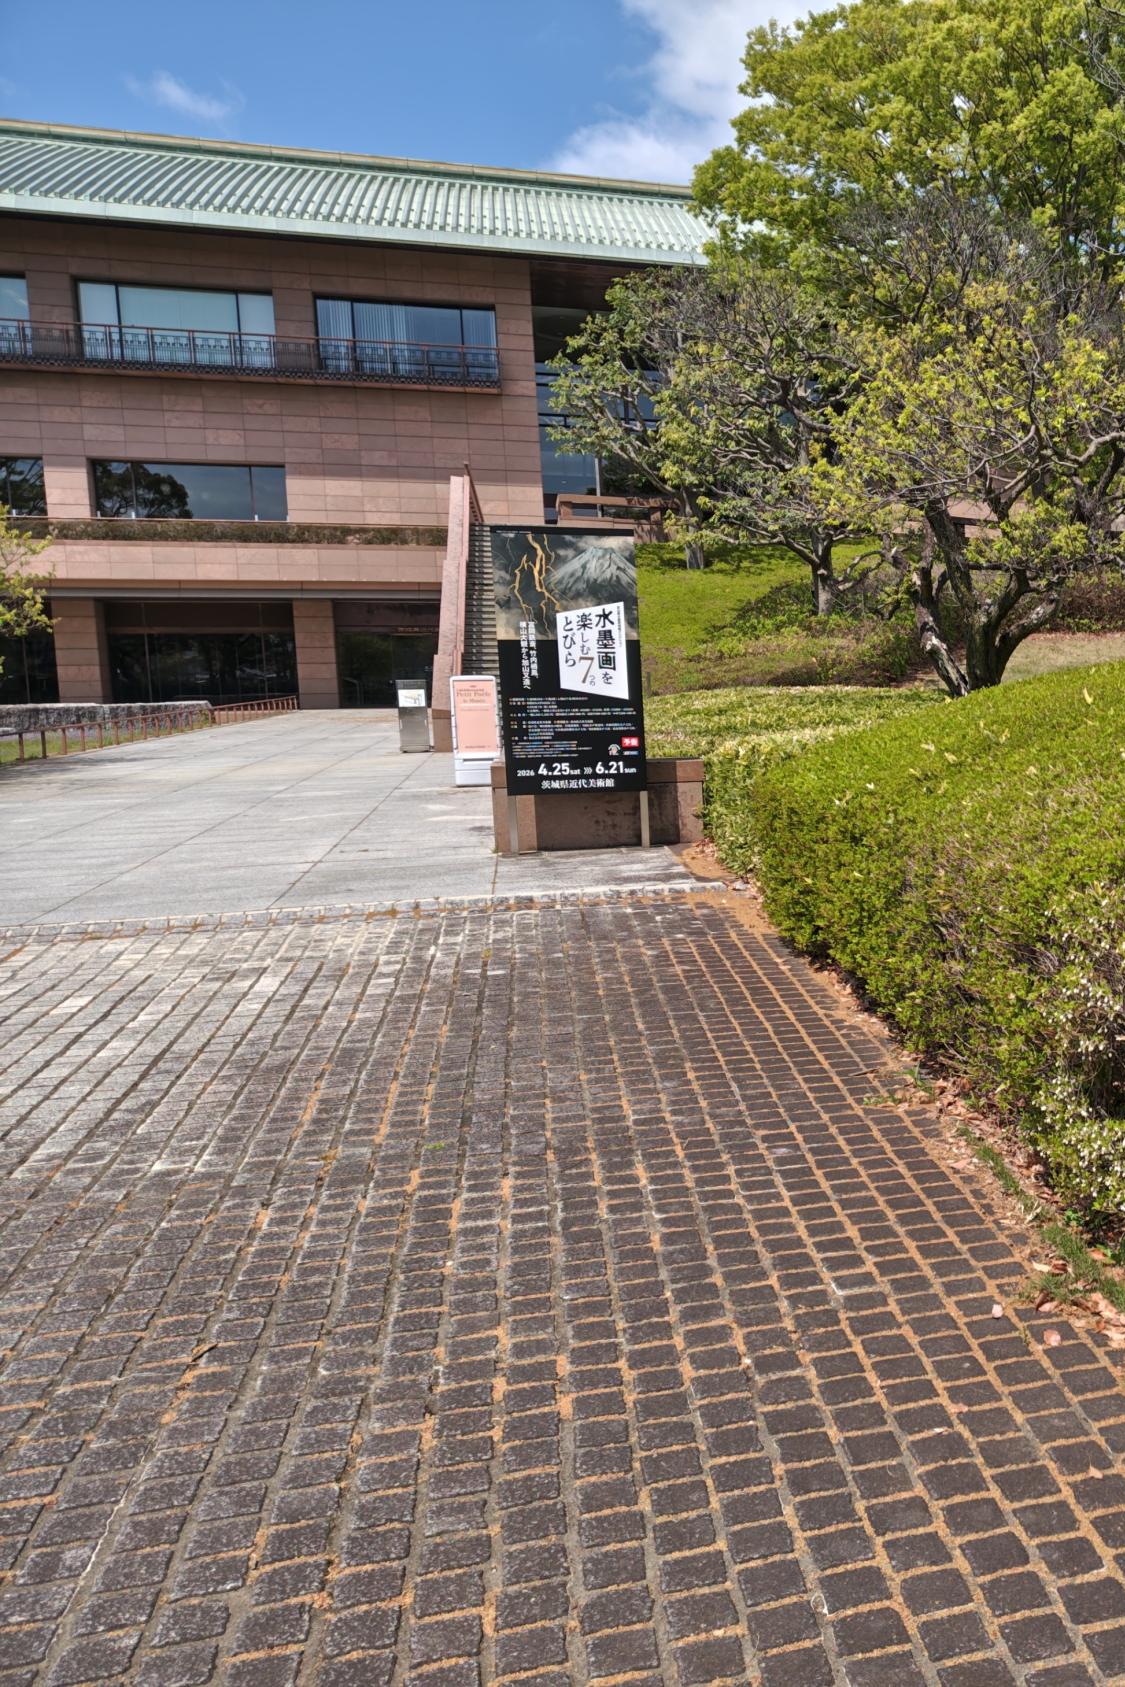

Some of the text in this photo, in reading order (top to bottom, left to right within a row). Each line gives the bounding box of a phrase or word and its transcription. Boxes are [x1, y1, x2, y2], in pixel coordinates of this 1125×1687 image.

[562, 616, 577, 668] とびら
[595, 608, 617, 685] 水墨画を
[517, 769, 535, 777] 2026
[541, 778, 615, 790] 茨城県近代美術館
